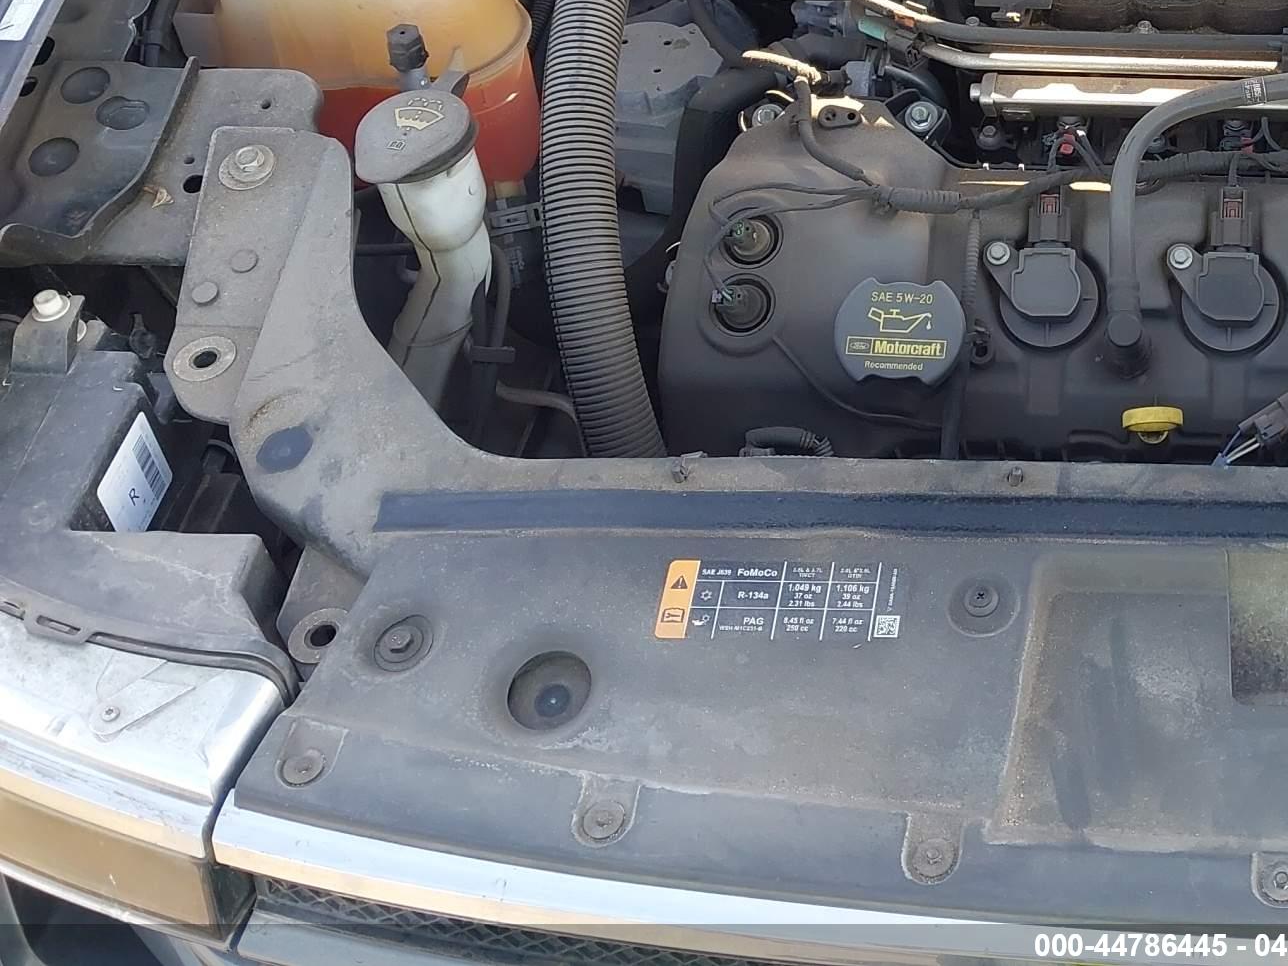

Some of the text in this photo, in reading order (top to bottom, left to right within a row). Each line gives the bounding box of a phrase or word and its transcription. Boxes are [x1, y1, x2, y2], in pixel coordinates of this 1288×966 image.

[871, 292, 933, 304] SAE 5W-20
[874, 340, 942, 356] Motorcraft
[864, 360, 924, 371] Recommended
[128, 488, 140, 506] R
[737, 568, 778, 576] FoMoCo
[811, 584, 821, 593] kg
[860, 585, 869, 594] kg
